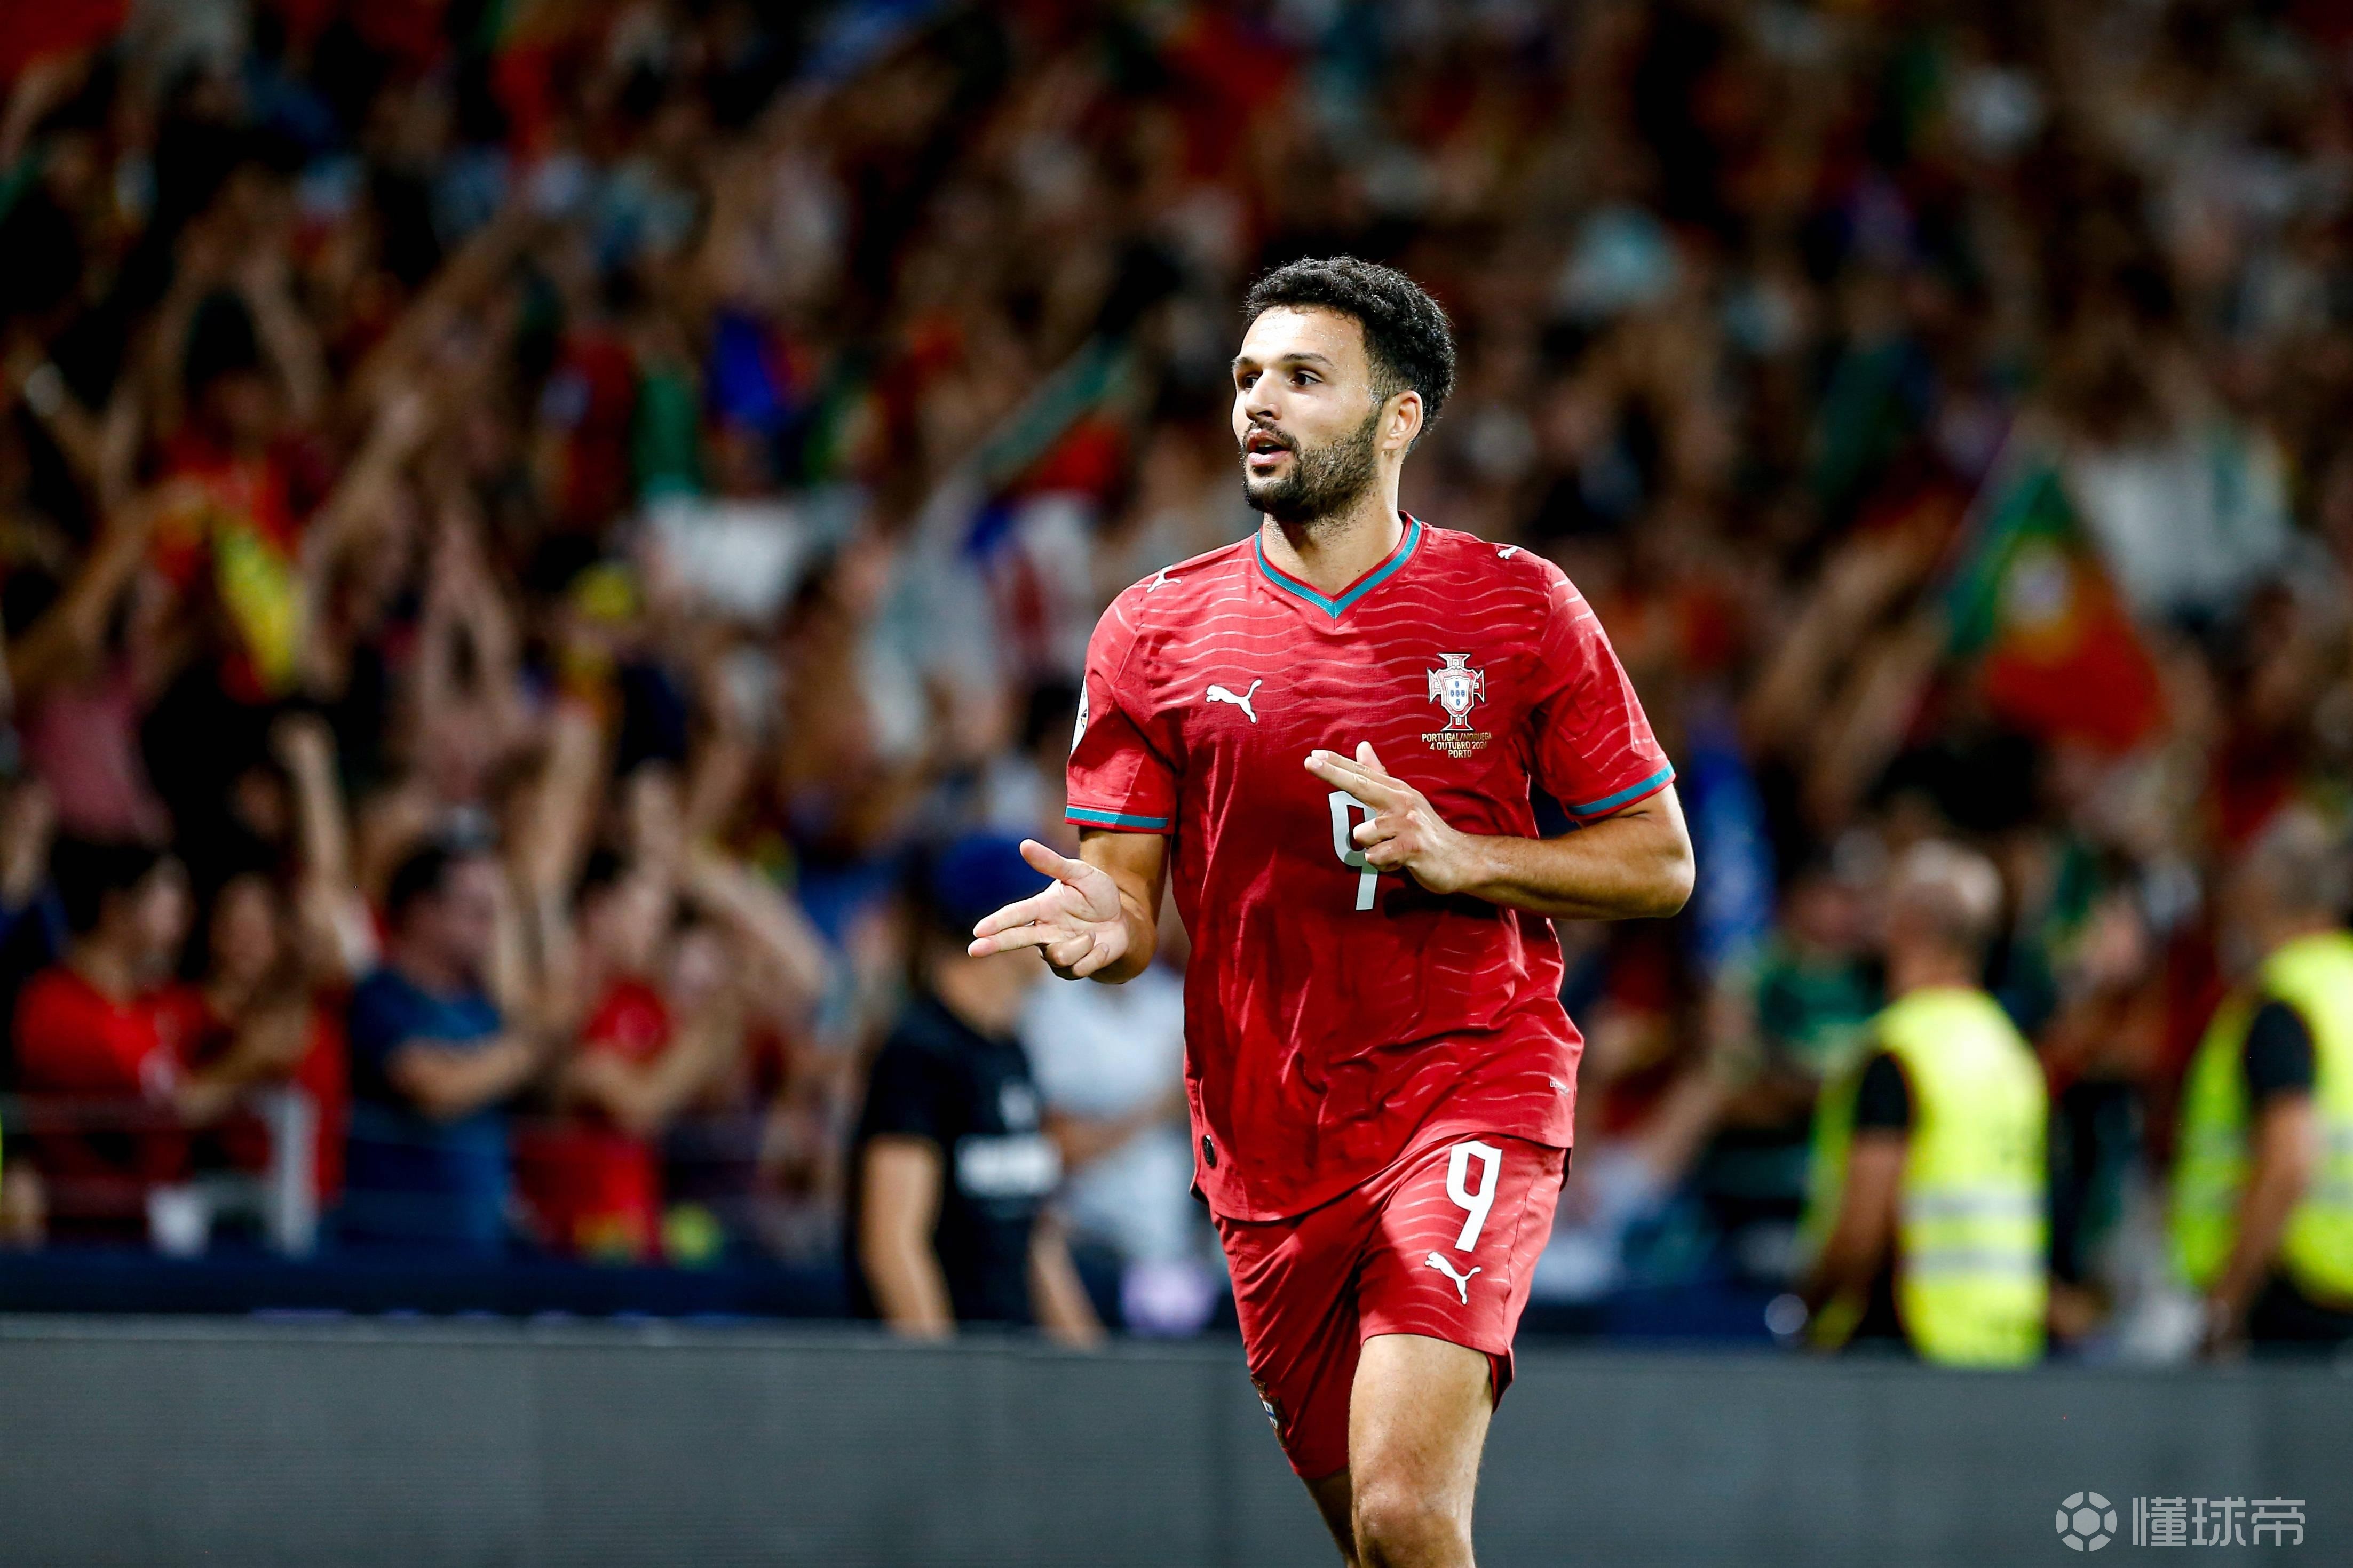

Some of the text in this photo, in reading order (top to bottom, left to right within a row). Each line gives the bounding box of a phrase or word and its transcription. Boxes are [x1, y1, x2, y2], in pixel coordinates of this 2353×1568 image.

[1430, 742, 1435, 750] 4
[1437, 741, 1470, 750] OUTUBRO
[1448, 749, 1472, 758] PORTO
[1328, 790, 1378, 910] 9
[1446, 1140, 1502, 1252] 9
